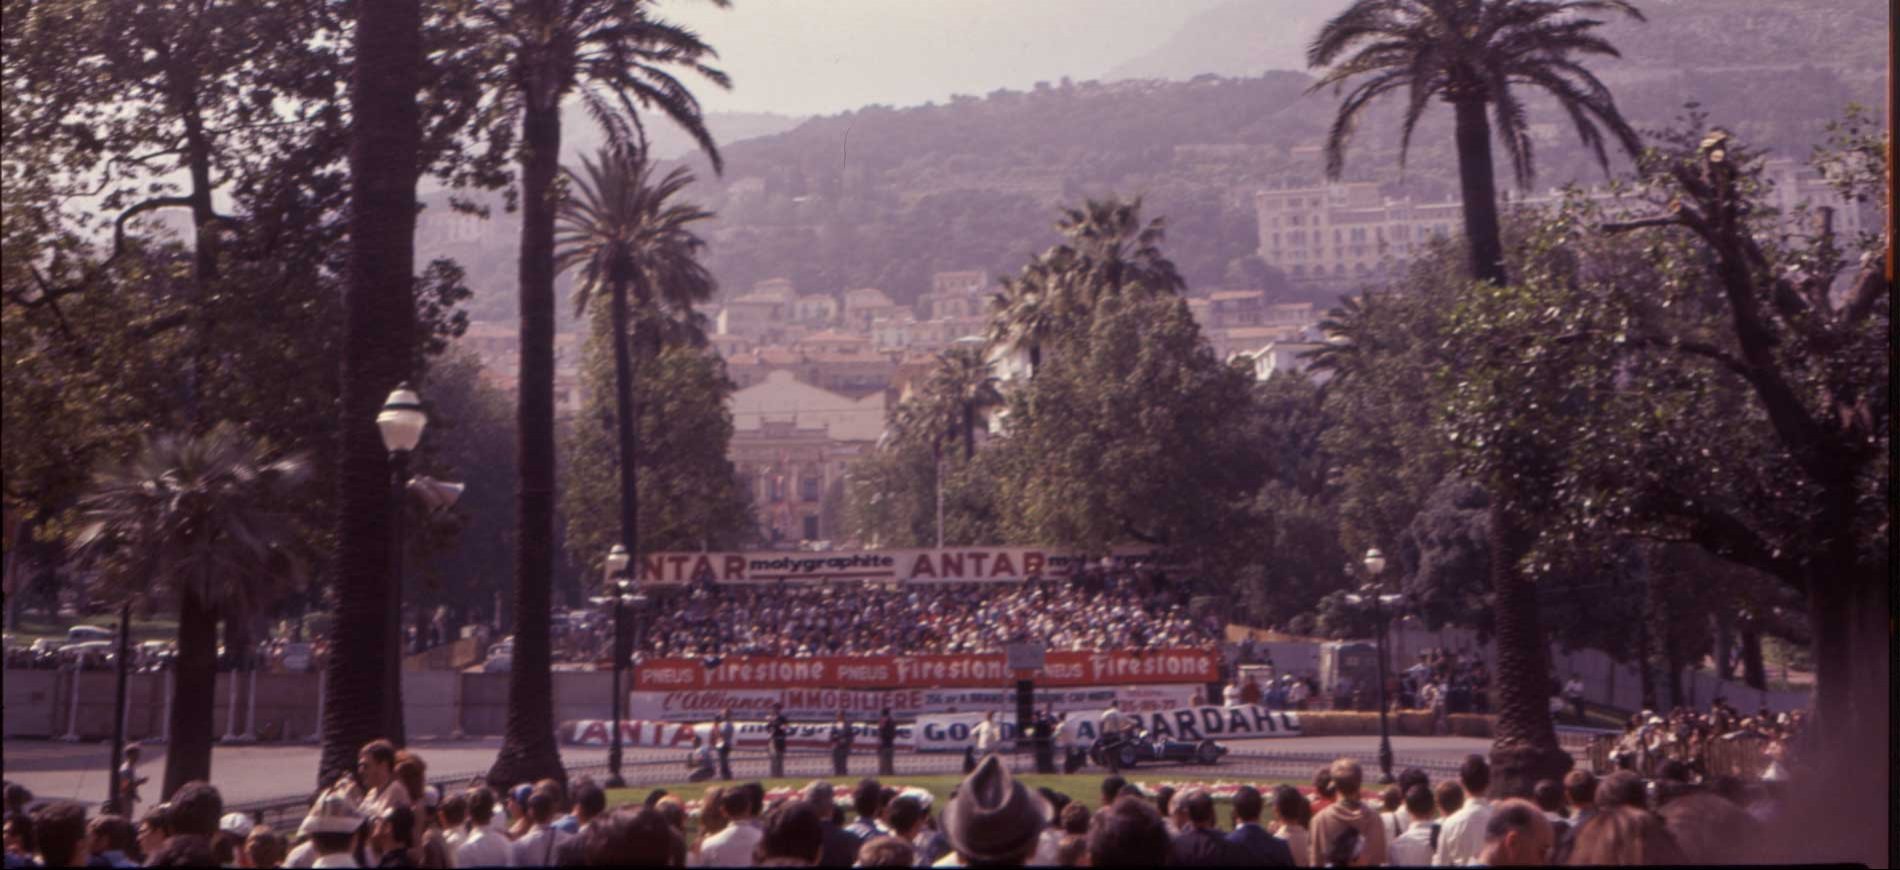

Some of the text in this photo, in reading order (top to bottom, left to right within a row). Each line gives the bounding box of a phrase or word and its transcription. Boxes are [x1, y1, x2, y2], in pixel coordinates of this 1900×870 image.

[751, 555, 895, 572] molygraphite
[910, 552, 1046, 578] ANTAR
[641, 667, 695, 684] PNEUS
[837, 664, 888, 681] PNEUS
[1088, 655, 1210, 680] Firestone
